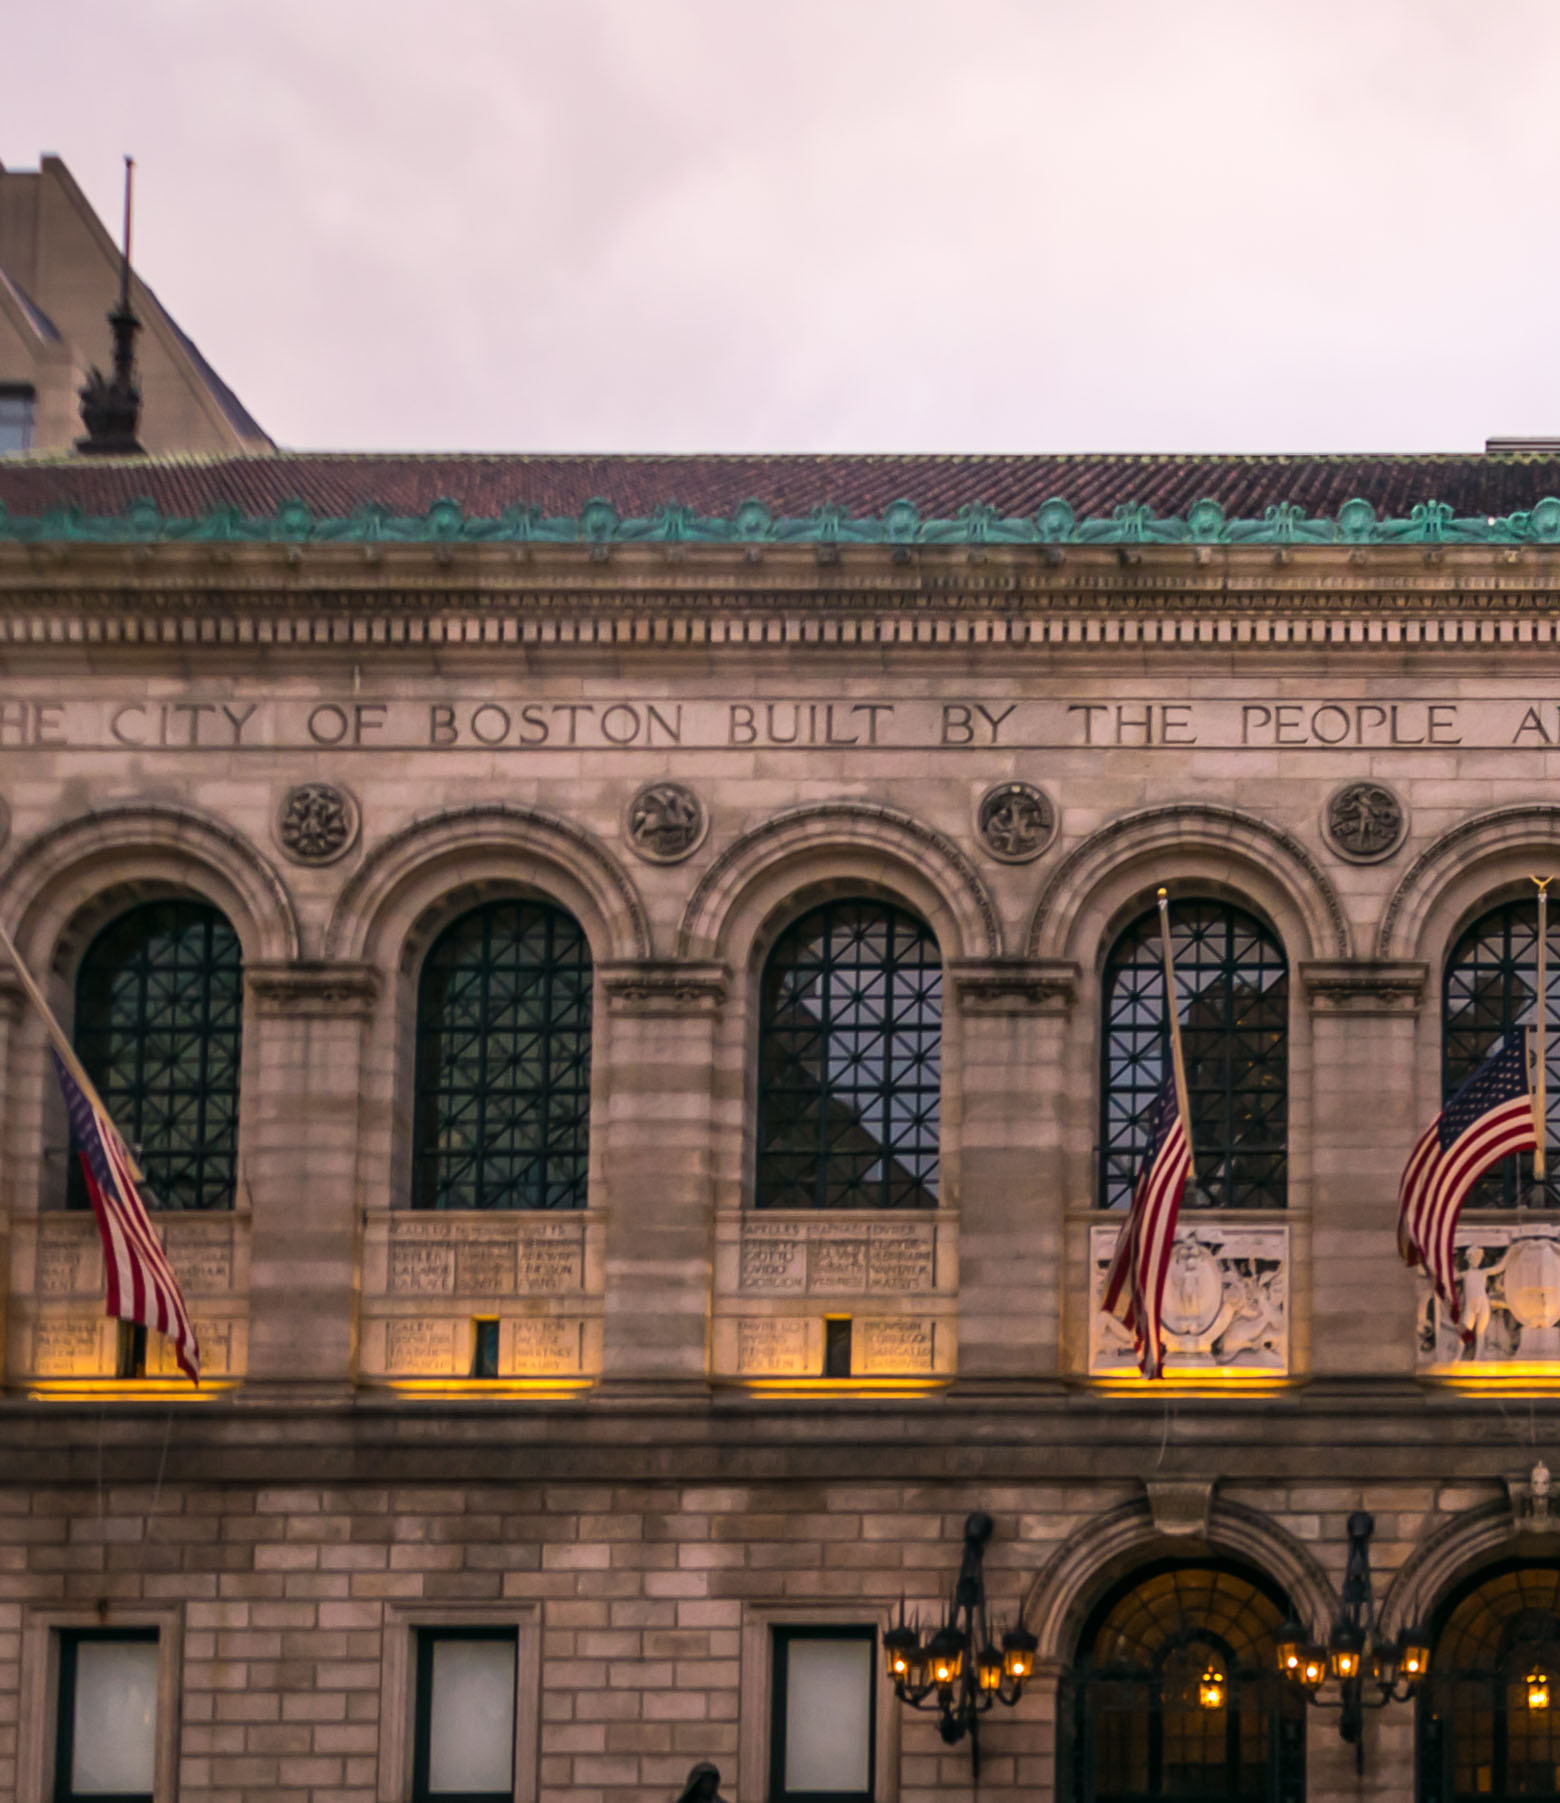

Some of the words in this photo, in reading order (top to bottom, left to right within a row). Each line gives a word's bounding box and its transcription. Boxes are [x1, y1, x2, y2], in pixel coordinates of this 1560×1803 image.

[110, 702, 258, 746] CITY
[307, 702, 388, 746] OF
[429, 702, 684, 746] BOSTON
[729, 702, 895, 746] BUILT
[940, 702, 1018, 746] BY
[1067, 702, 1197, 746] THE
[1240, 702, 1463, 746] PEOPLE
